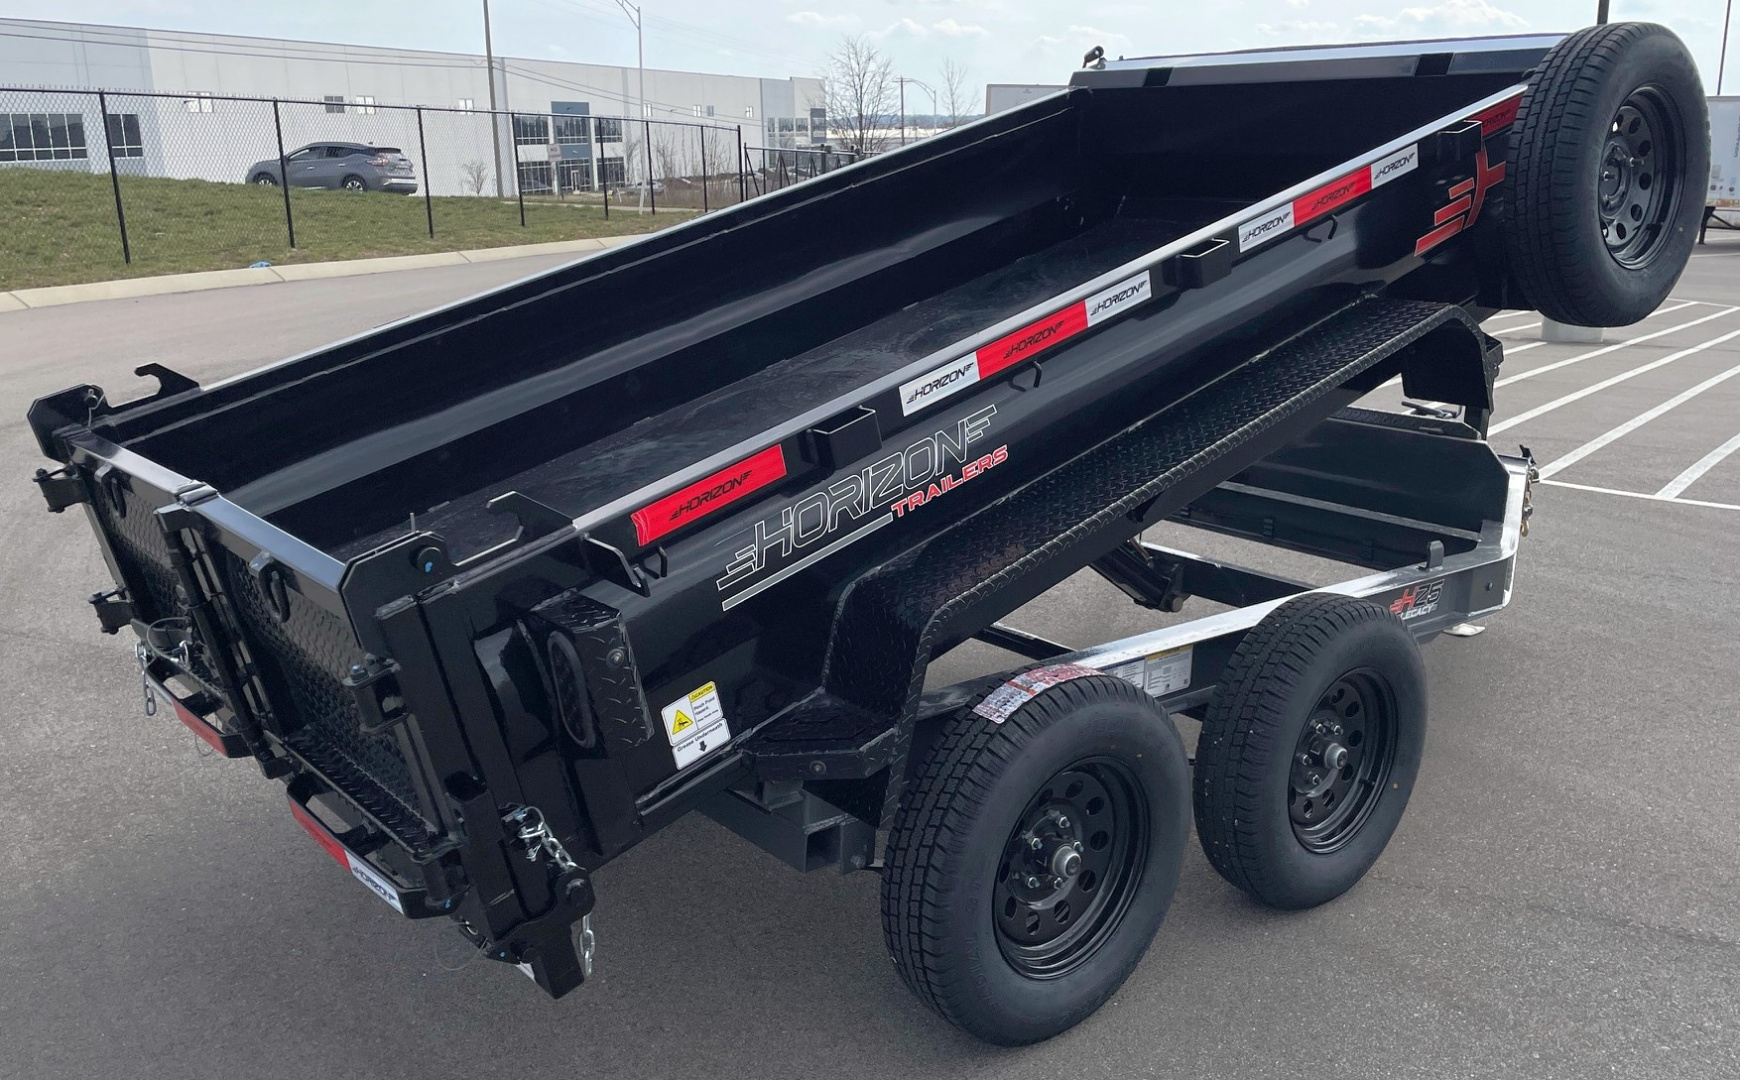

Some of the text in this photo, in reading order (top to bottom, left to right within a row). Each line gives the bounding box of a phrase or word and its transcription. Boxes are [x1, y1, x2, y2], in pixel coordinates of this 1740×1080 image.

[1377, 155, 1412, 178] HORIZON
[1314, 184, 1353, 209] HORIZON
[1246, 213, 1287, 241] HORIZON
[1094, 282, 1144, 314] HORIZON
[1008, 323, 1061, 357] HORIZON
[910, 365, 970, 403] HORIZON
[674, 472, 747, 518] HORIZON
[738, 413, 981, 578] HORIZON
[891, 444, 1009, 517] TRAILERS
[1400, 604, 1434, 620] LEGACY
